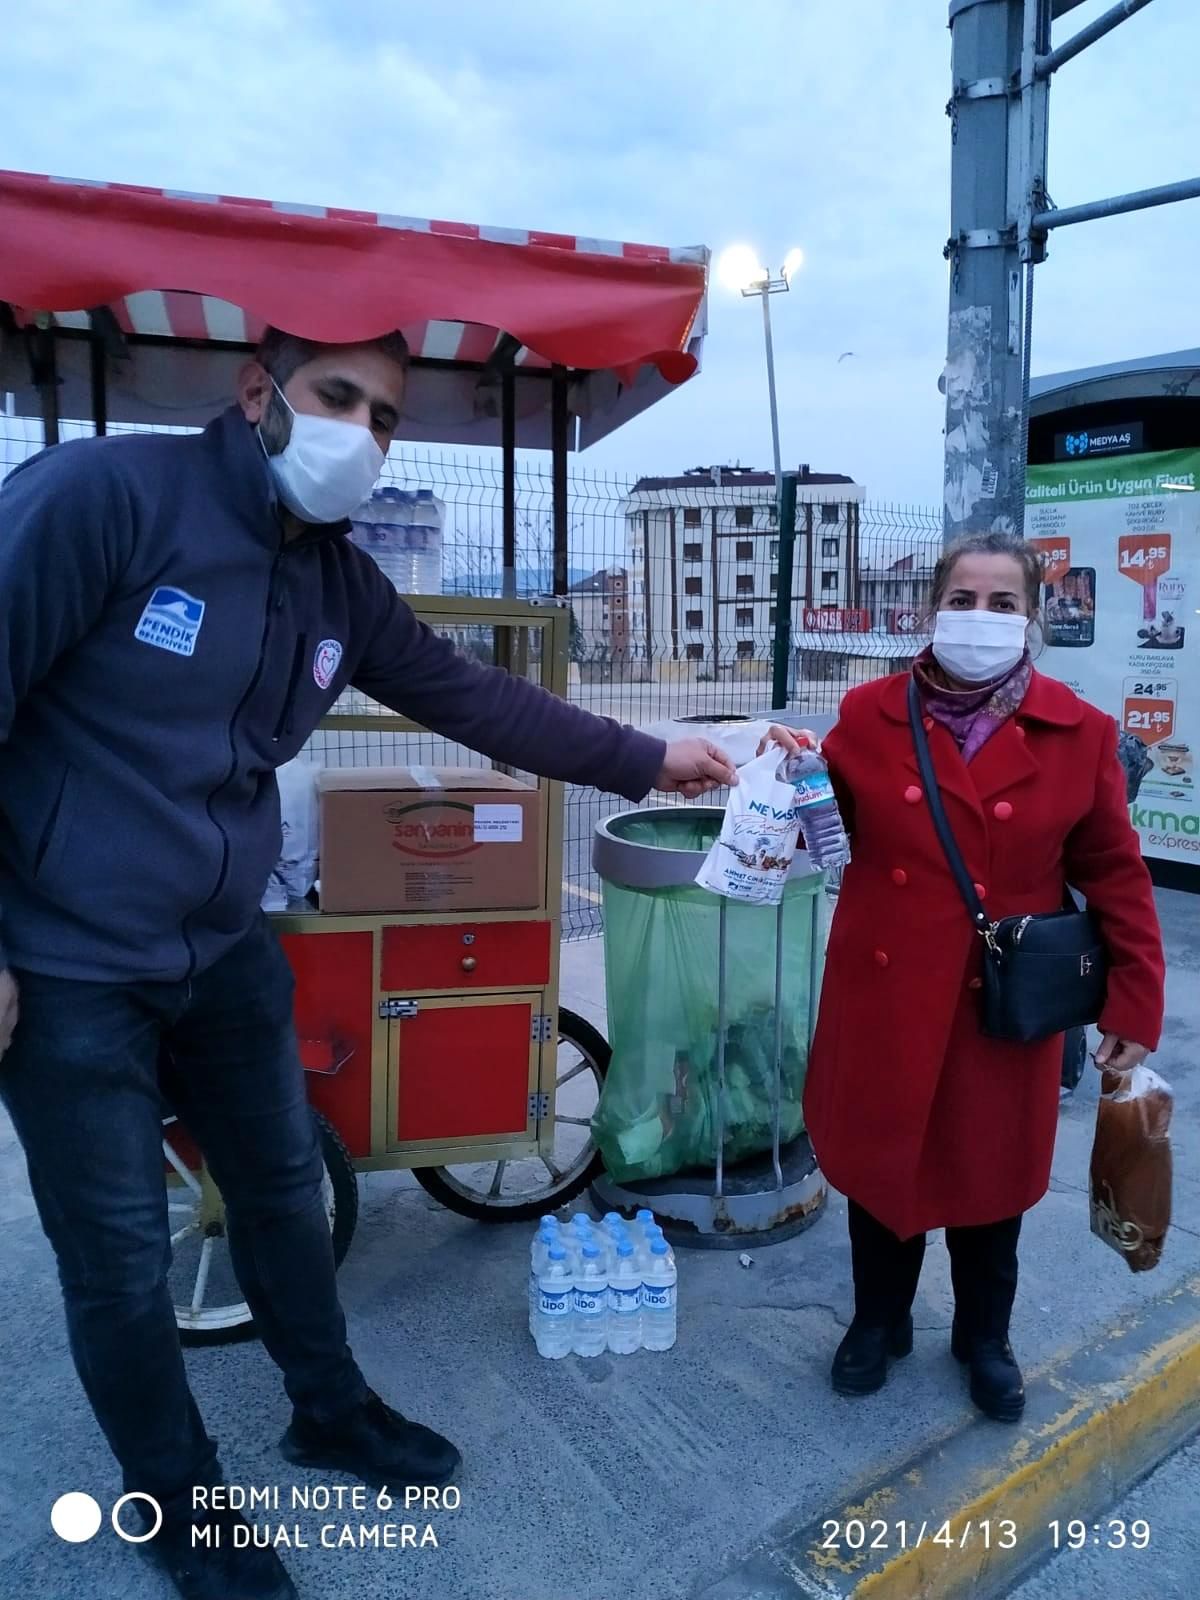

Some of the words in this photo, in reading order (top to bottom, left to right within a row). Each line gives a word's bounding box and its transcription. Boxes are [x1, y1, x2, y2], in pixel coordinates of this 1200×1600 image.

[1089, 434, 1118, 447] MEDYA
[1119, 432, 1131, 444] AŞ
[1068, 479, 1103, 496] Ürün
[1106, 478, 1152, 495] Uygun
[1156, 472, 1195, 489] Fiyat
[1148, 832, 1200, 852] expres
